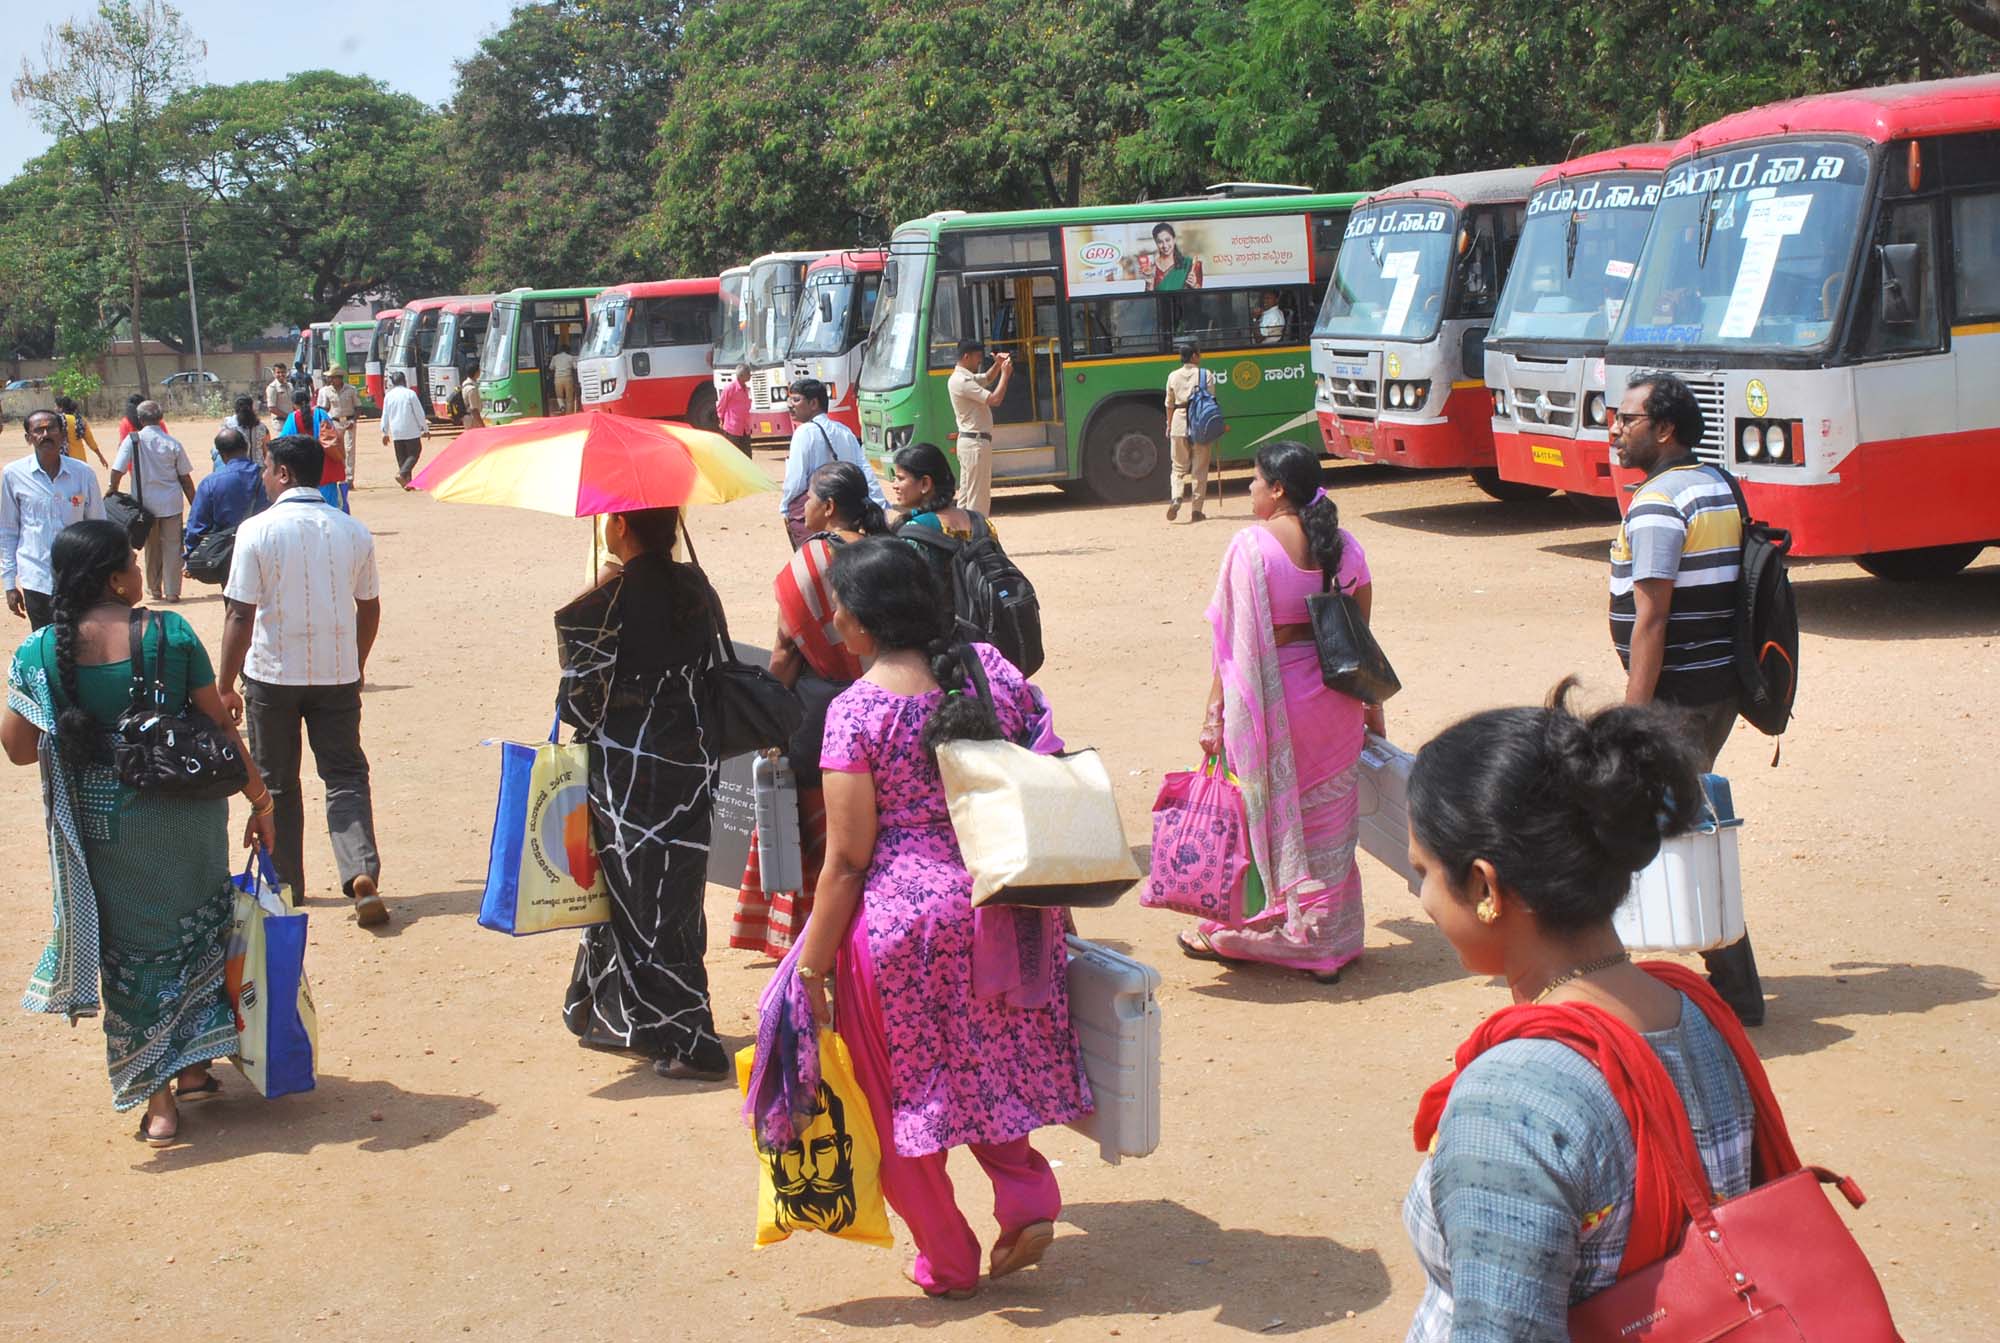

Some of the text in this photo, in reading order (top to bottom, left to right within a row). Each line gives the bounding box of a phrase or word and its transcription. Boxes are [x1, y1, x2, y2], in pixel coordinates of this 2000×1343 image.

[1086, 247, 1114, 260] GRB
[1264, 363, 1305, 381] ಸಾರಿಗೆ
[716, 794, 748, 808] LECTION
